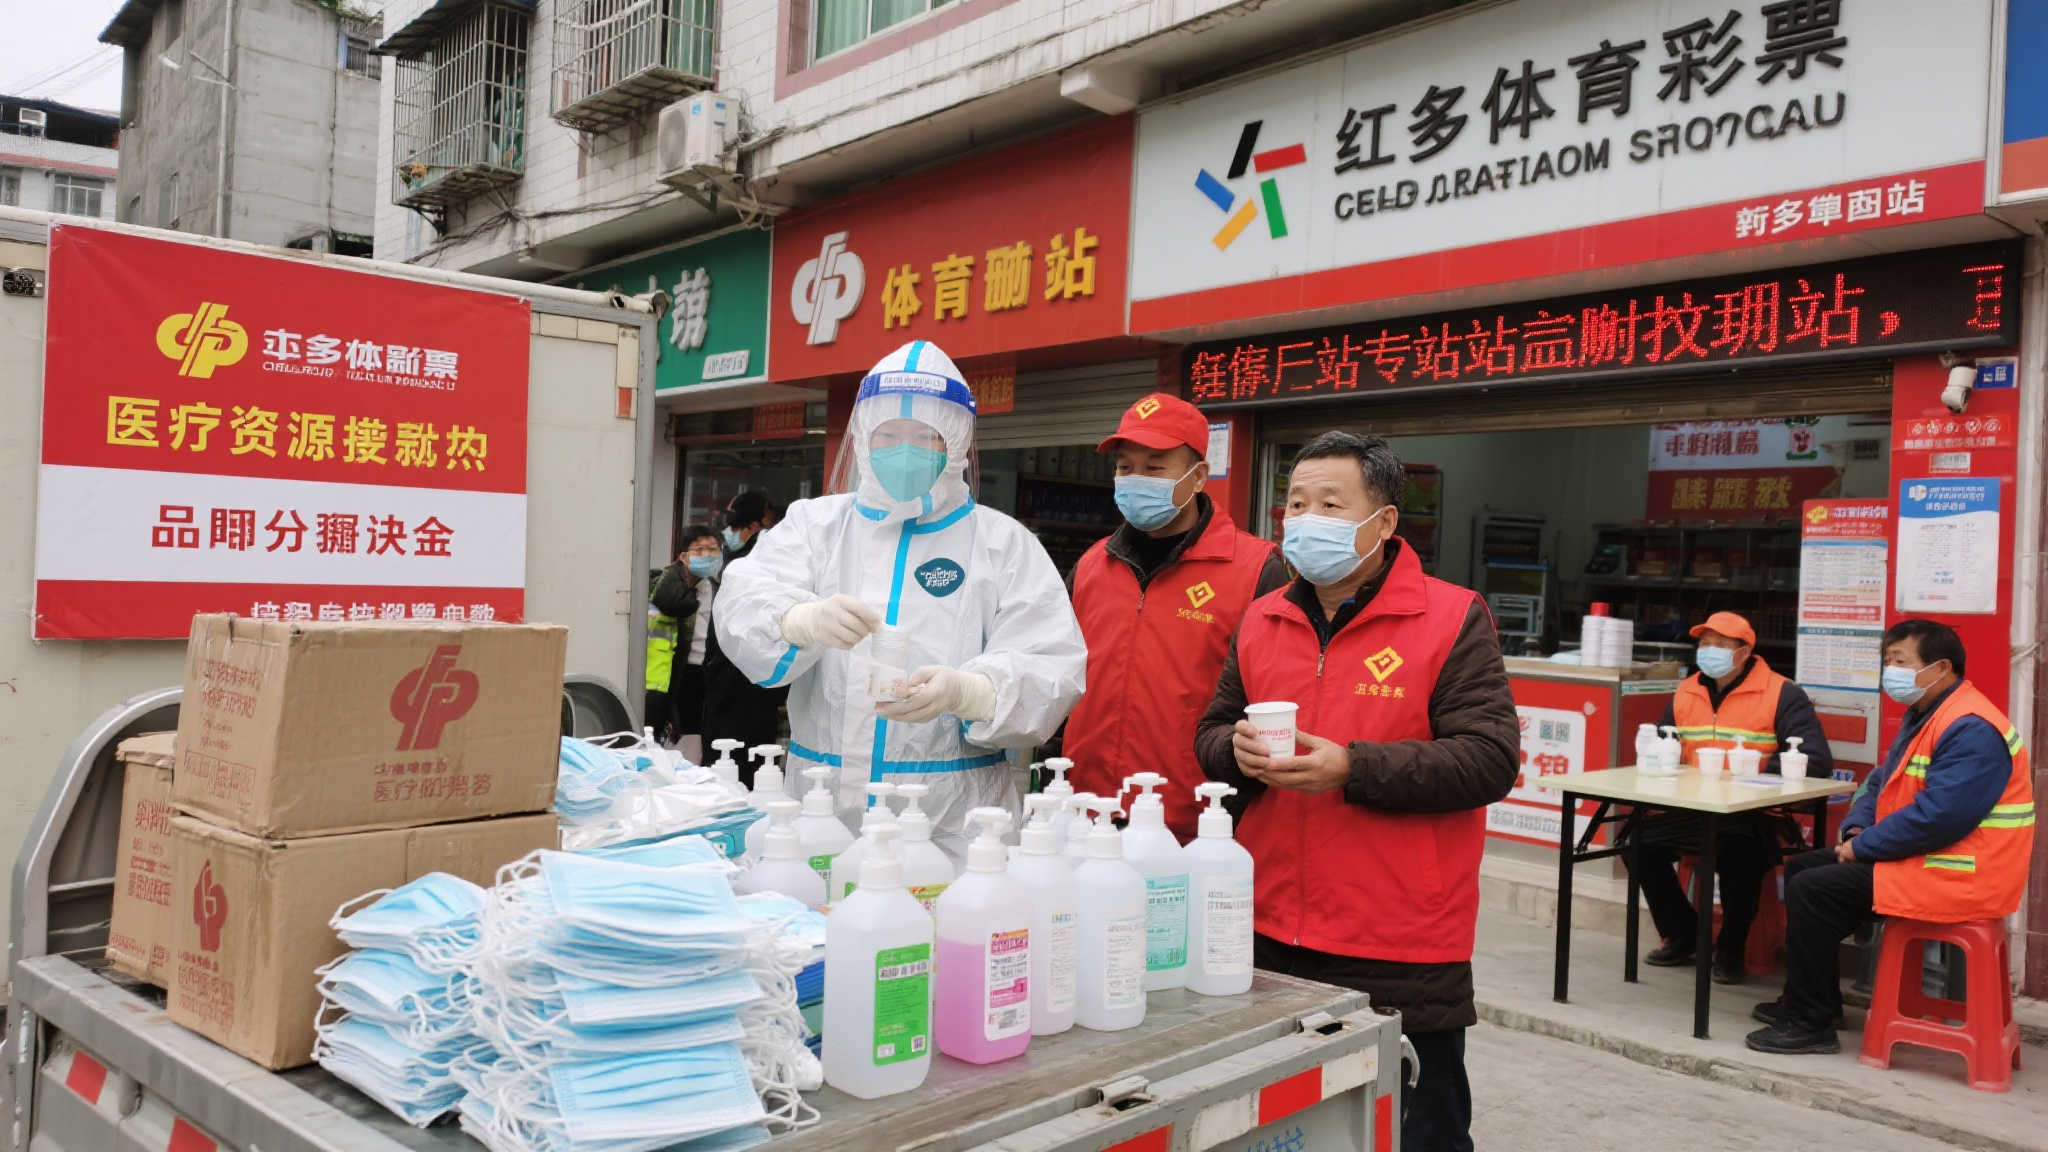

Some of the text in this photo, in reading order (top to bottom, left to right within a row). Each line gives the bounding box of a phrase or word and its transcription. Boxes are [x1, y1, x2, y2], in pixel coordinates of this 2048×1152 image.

[1334, 0, 1848, 176] 红多体育彩票
